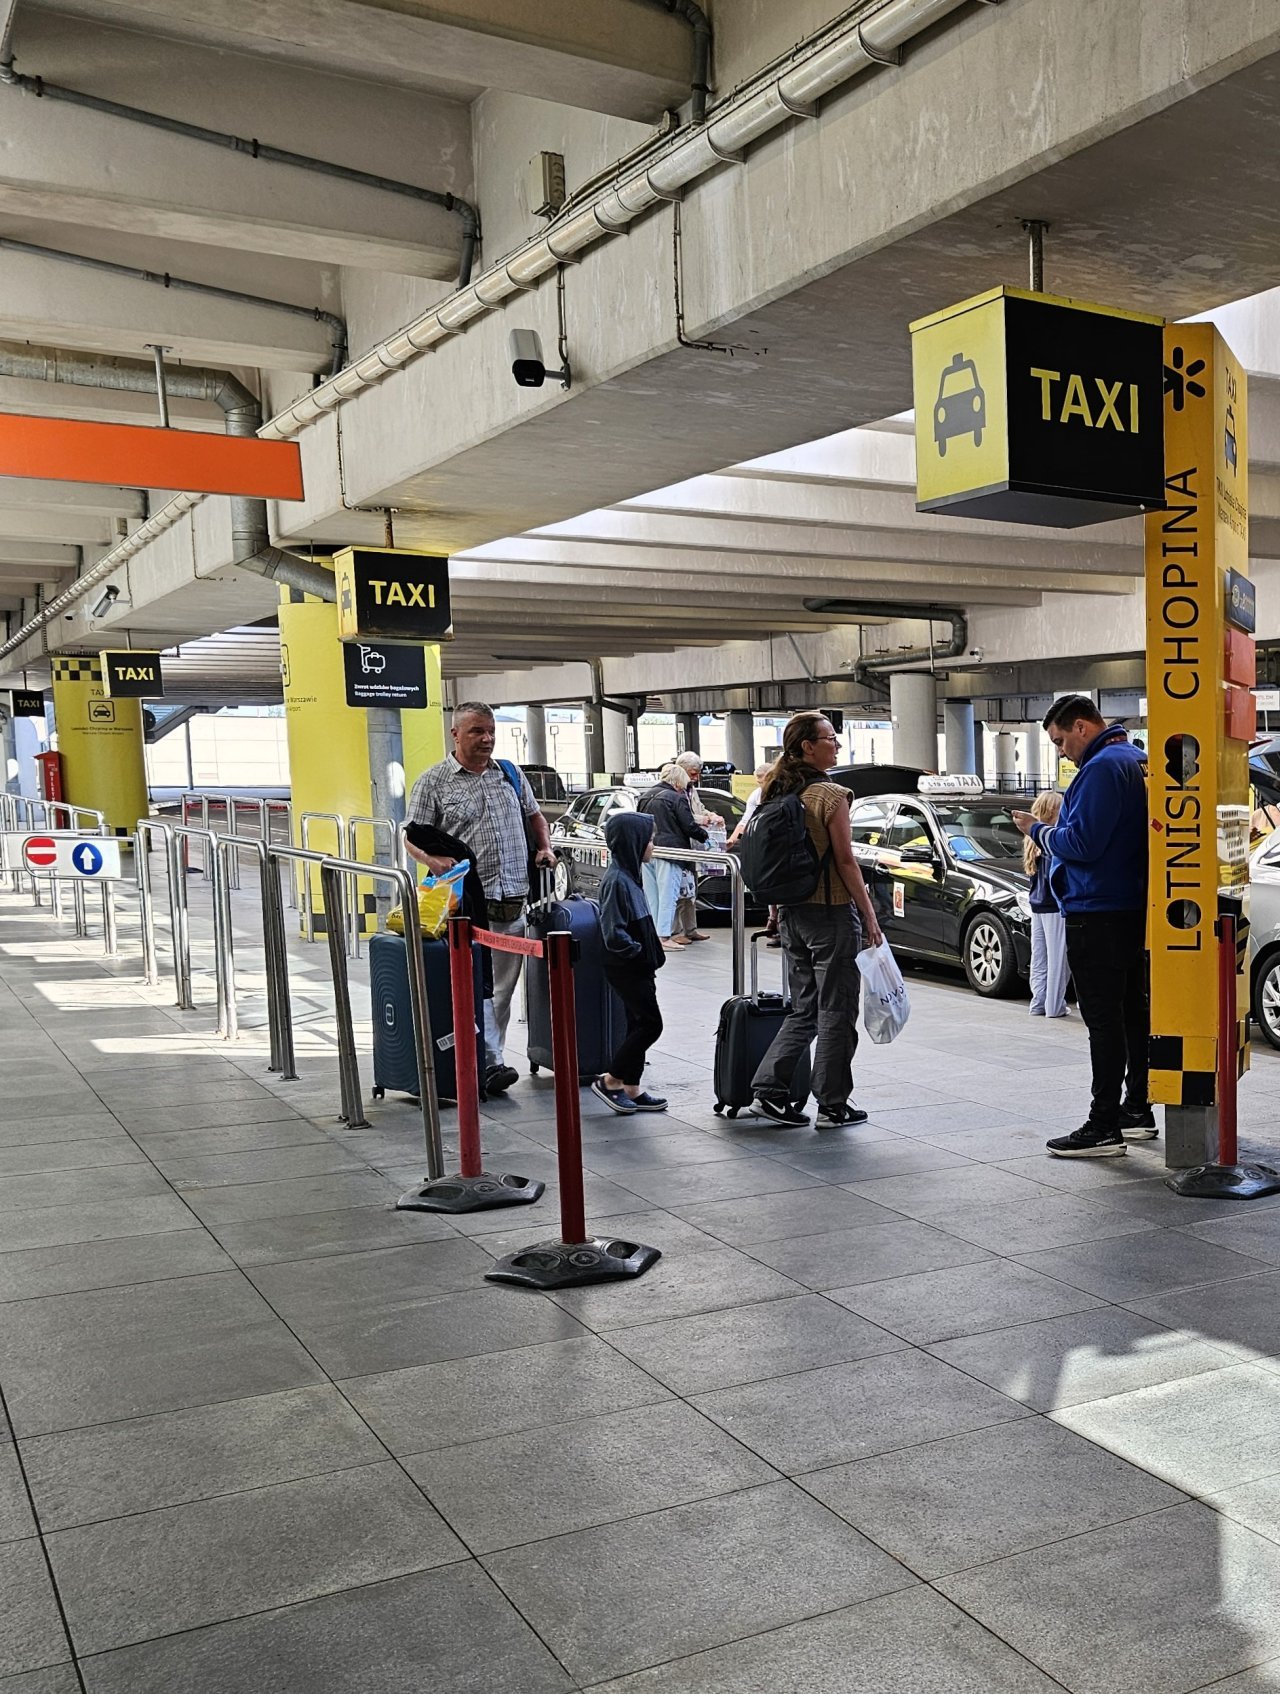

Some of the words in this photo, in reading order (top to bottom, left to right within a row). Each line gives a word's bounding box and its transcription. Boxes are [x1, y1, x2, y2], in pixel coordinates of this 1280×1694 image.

[1030, 367, 1139, 433] TAXI
[1162, 467, 1200, 699] CHOPINA
[368, 580, 435, 608] TAXI
[114, 667, 154, 681] TAXI
[17, 699, 40, 708] TAXI
[954, 776, 981, 787] TAXI
